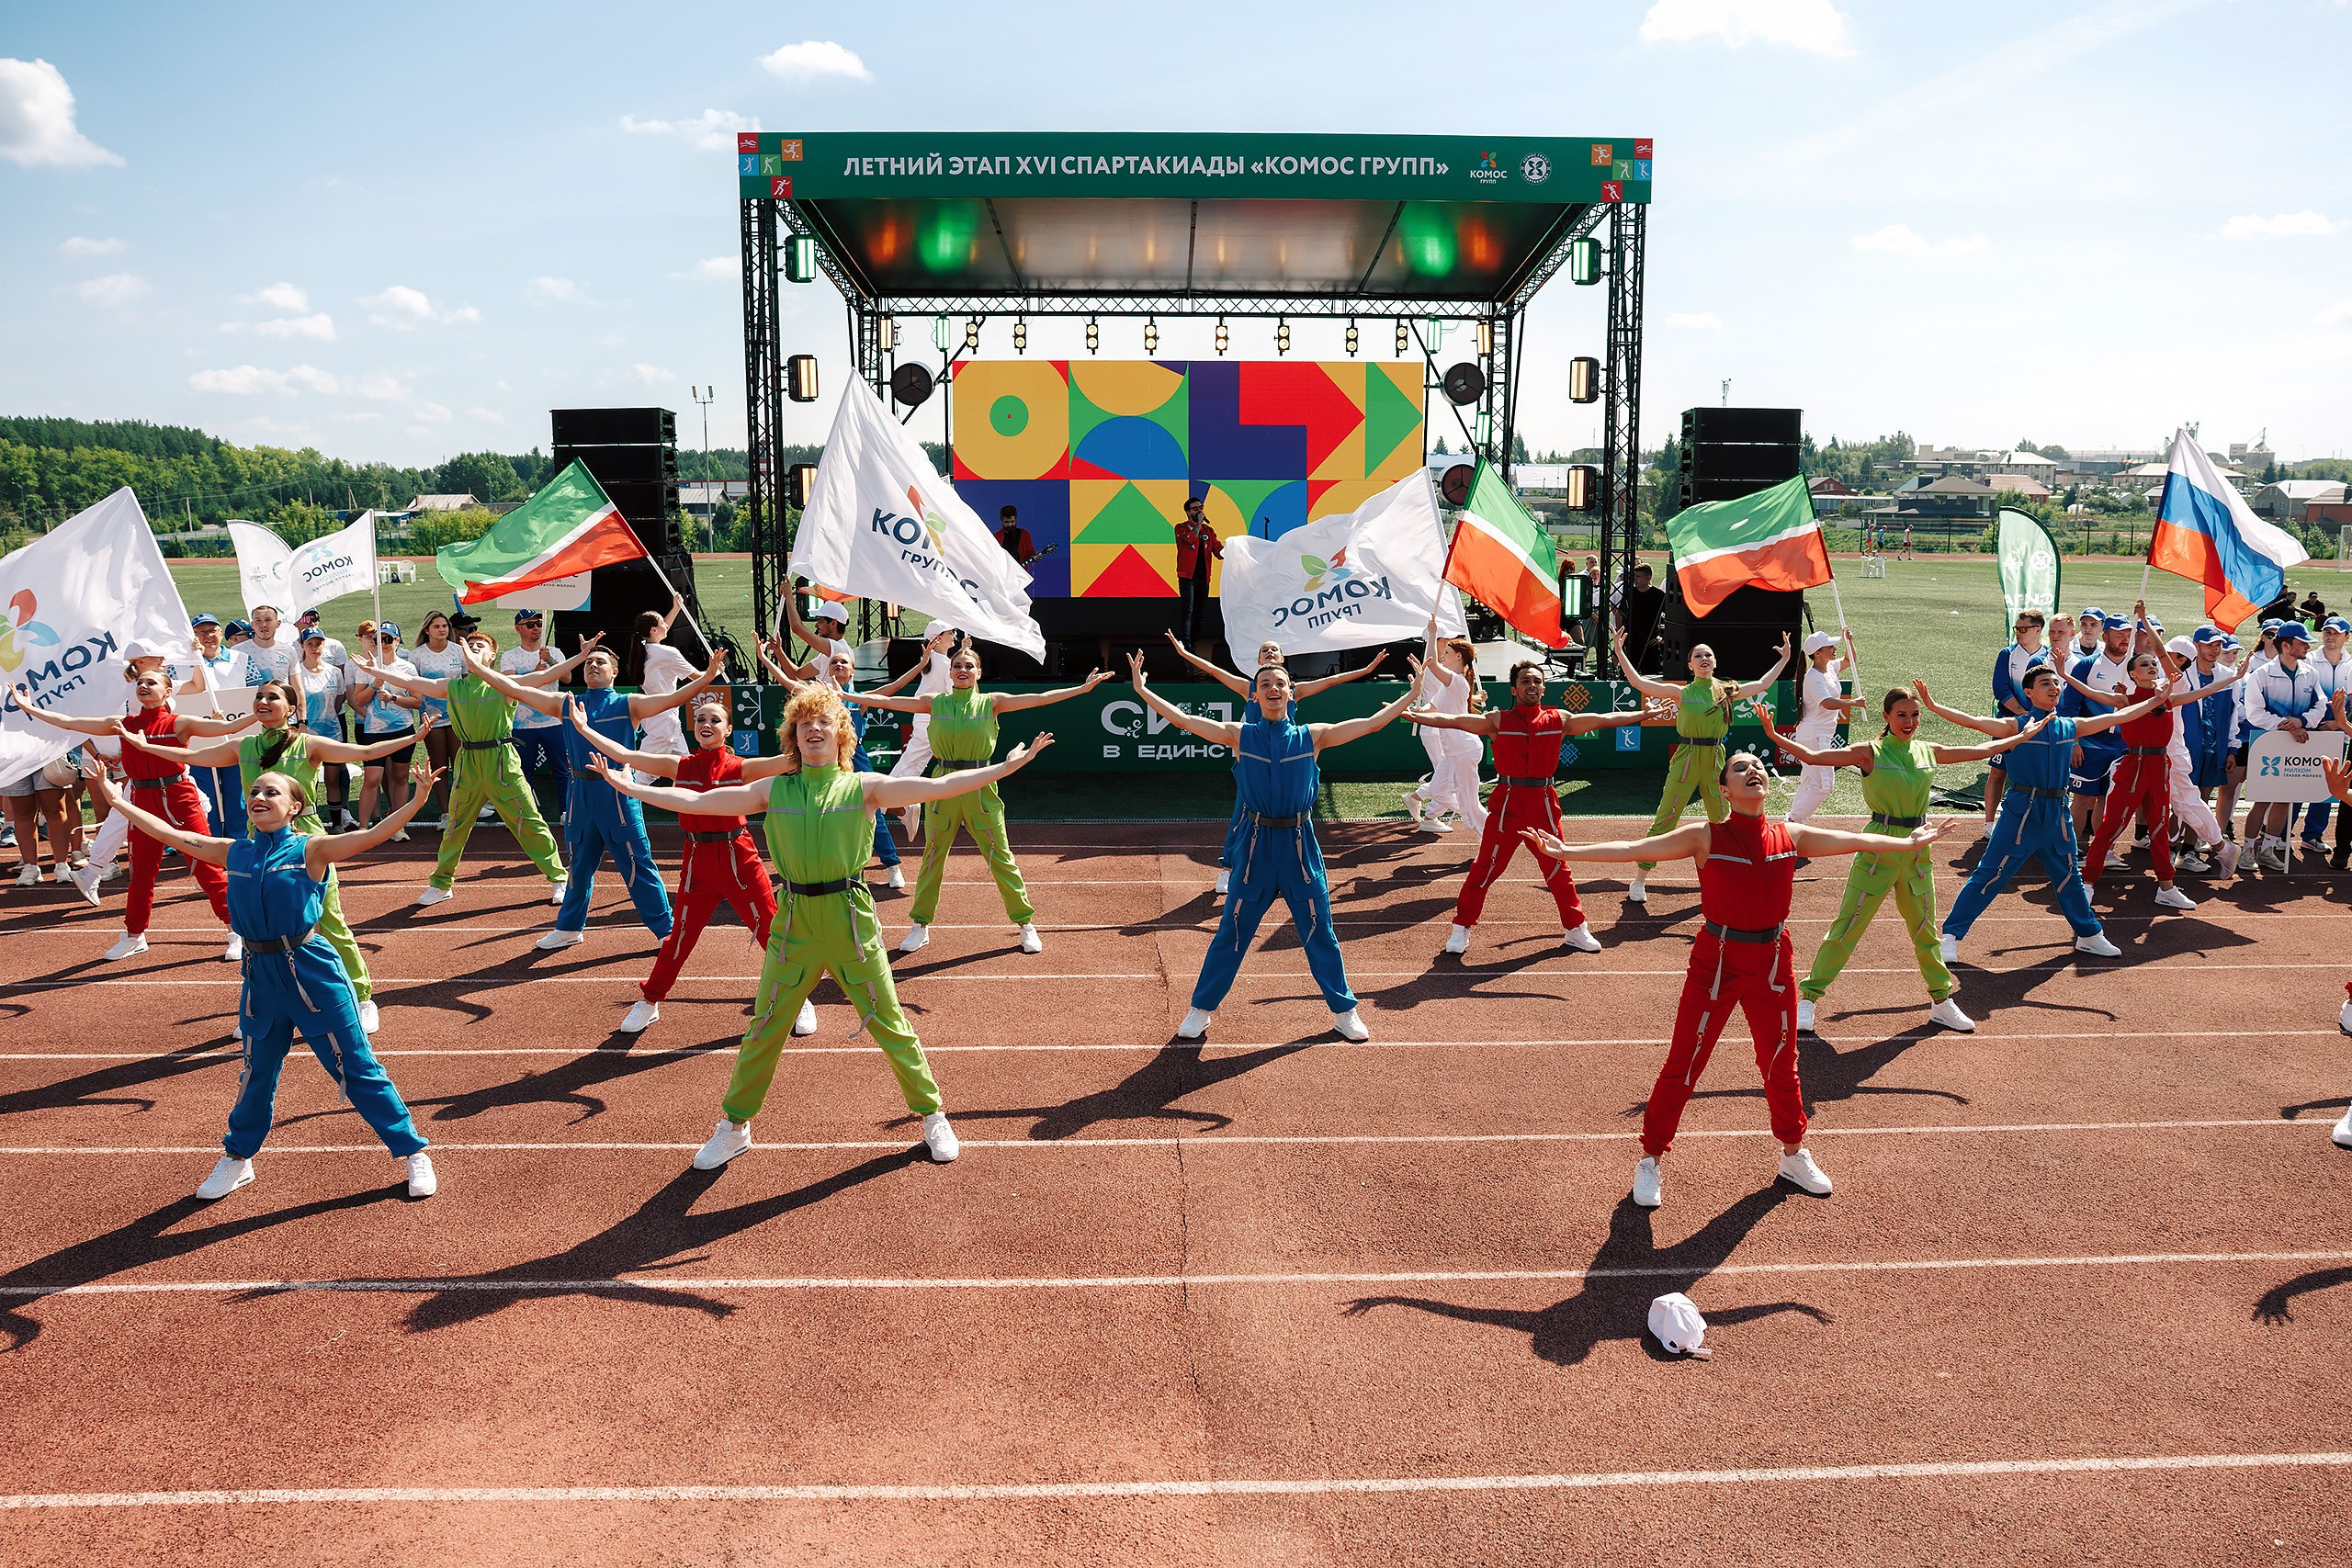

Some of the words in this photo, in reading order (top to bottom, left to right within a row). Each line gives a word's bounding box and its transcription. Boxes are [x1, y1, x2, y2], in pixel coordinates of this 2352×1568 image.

[843, 152, 944, 176] ЛЕТНИЙ
[948, 156, 1011, 175] ЭТАП
[1060, 155, 1245, 177] СПАРТАКИАДЫ
[1250, 155, 1355, 175] «КОМОС
[1360, 156, 1450, 175] ГРУПП»
[1470, 170, 1507, 178] КОМОС
[900, 549, 954, 583] ГРУП
[1102, 745, 1121, 758] В
[2284, 756, 2322, 766] КОМО
